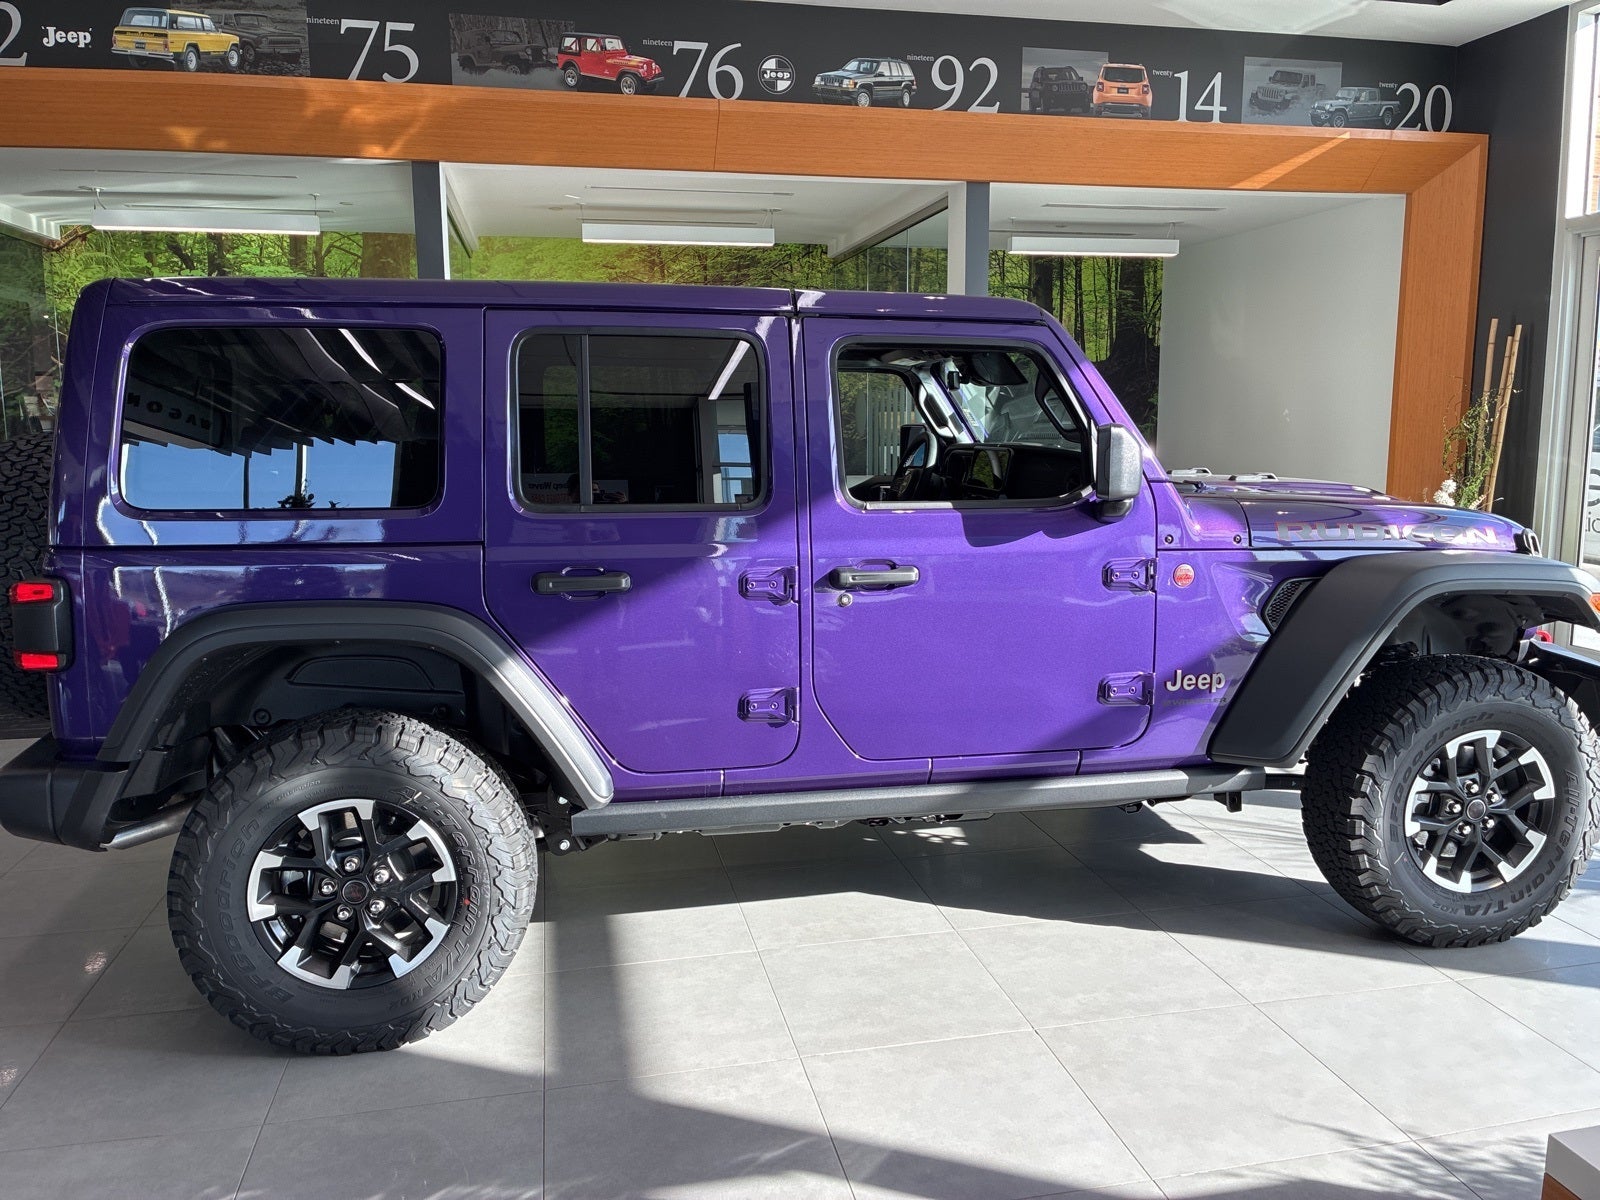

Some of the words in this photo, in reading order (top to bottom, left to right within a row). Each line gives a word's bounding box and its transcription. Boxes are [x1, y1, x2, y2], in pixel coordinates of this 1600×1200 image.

[306, 15, 340, 25] nineteen
[340, 18, 420, 84] 75
[642, 38, 673, 47] nineteen
[673, 40, 745, 100] 76
[764, 70, 791, 82] Jeep
[906, 53, 935, 62] nineteen
[931, 55, 1000, 113] 92
[1152, 69, 1173, 79] twenty
[1174, 70, 1228, 123] 14
[1378, 81, 1399, 90] twenty
[1395, 82, 1453, 133] 20
[1275, 521, 1499, 545] RUBICON
[1165, 669, 1226, 693] Jeep
[215, 817, 296, 1006] BFGoodrich
